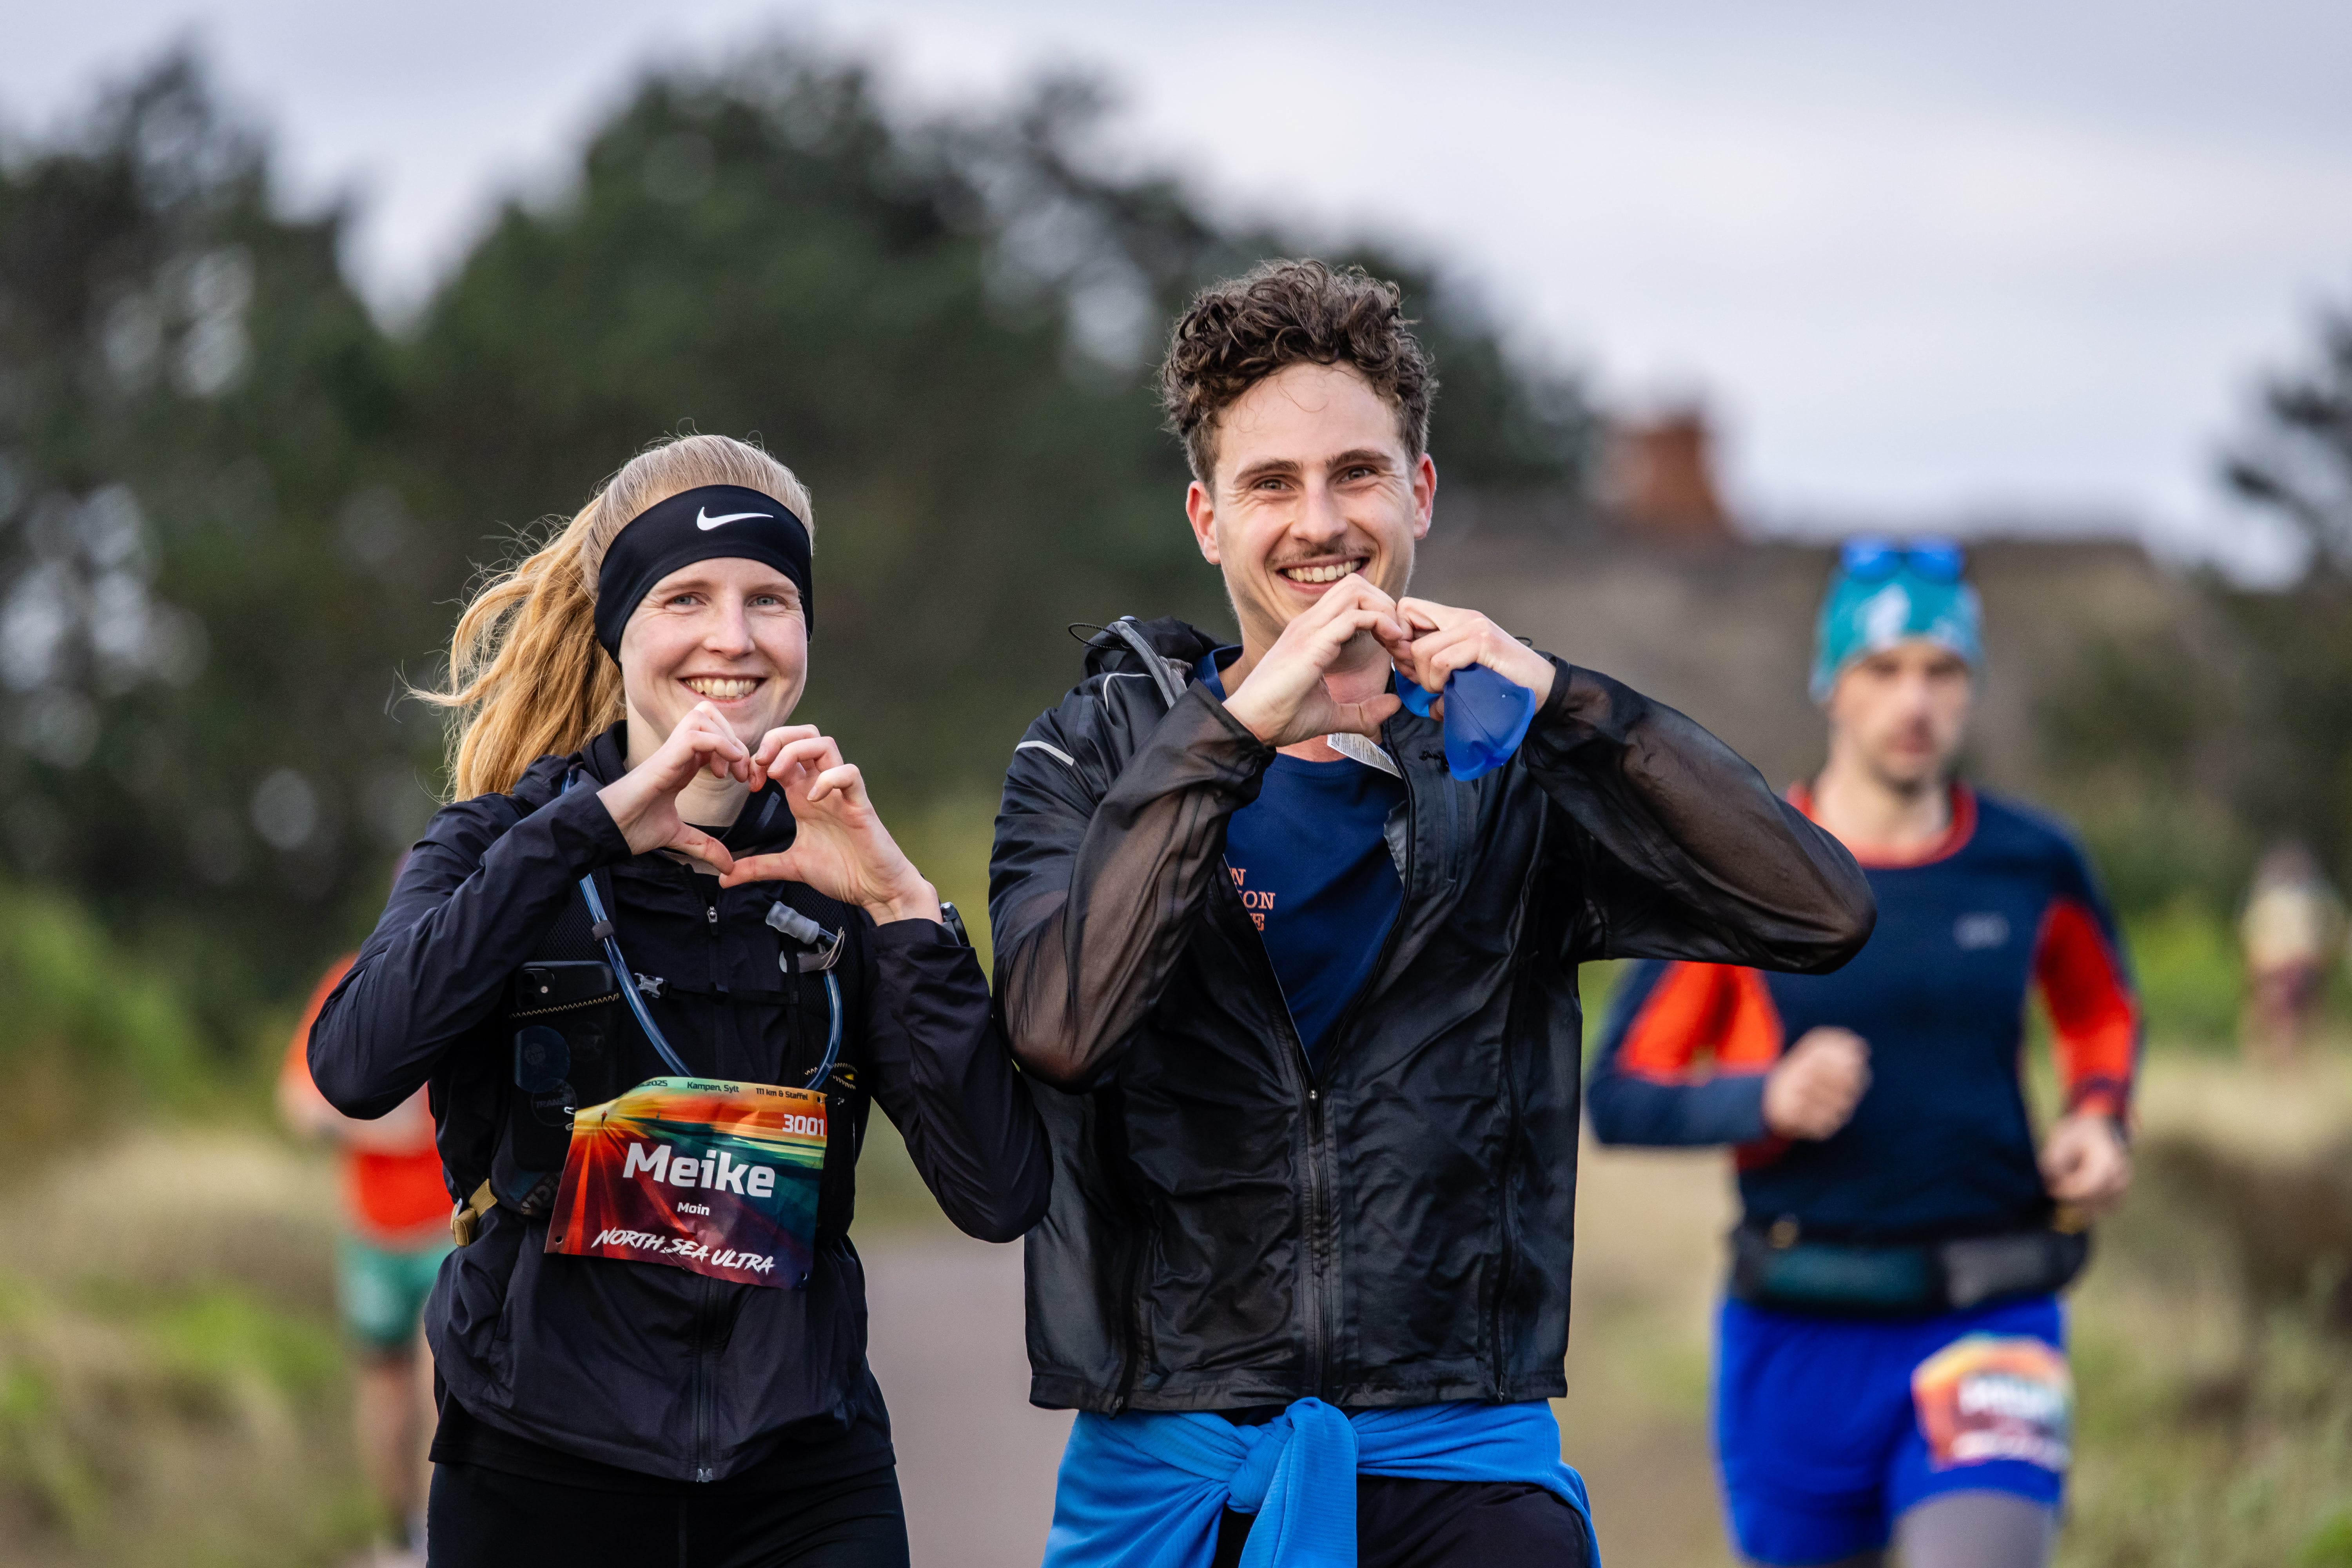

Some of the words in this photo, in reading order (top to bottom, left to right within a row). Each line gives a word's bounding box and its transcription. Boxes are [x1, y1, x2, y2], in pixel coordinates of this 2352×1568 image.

[1237, 890, 1276, 910] ON
[687, 1082, 722, 1092] Kampen,
[724, 1085, 739, 1094] Sylt
[785, 1091, 808, 1100] Staffel
[782, 1114, 824, 1137] 3001
[622, 1142, 775, 1198] Meike
[677, 1201, 710, 1216] Moin
[591, 1227, 666, 1251] NORTH
[659, 1238, 710, 1263] SEA
[711, 1248, 776, 1276] ULTRA
